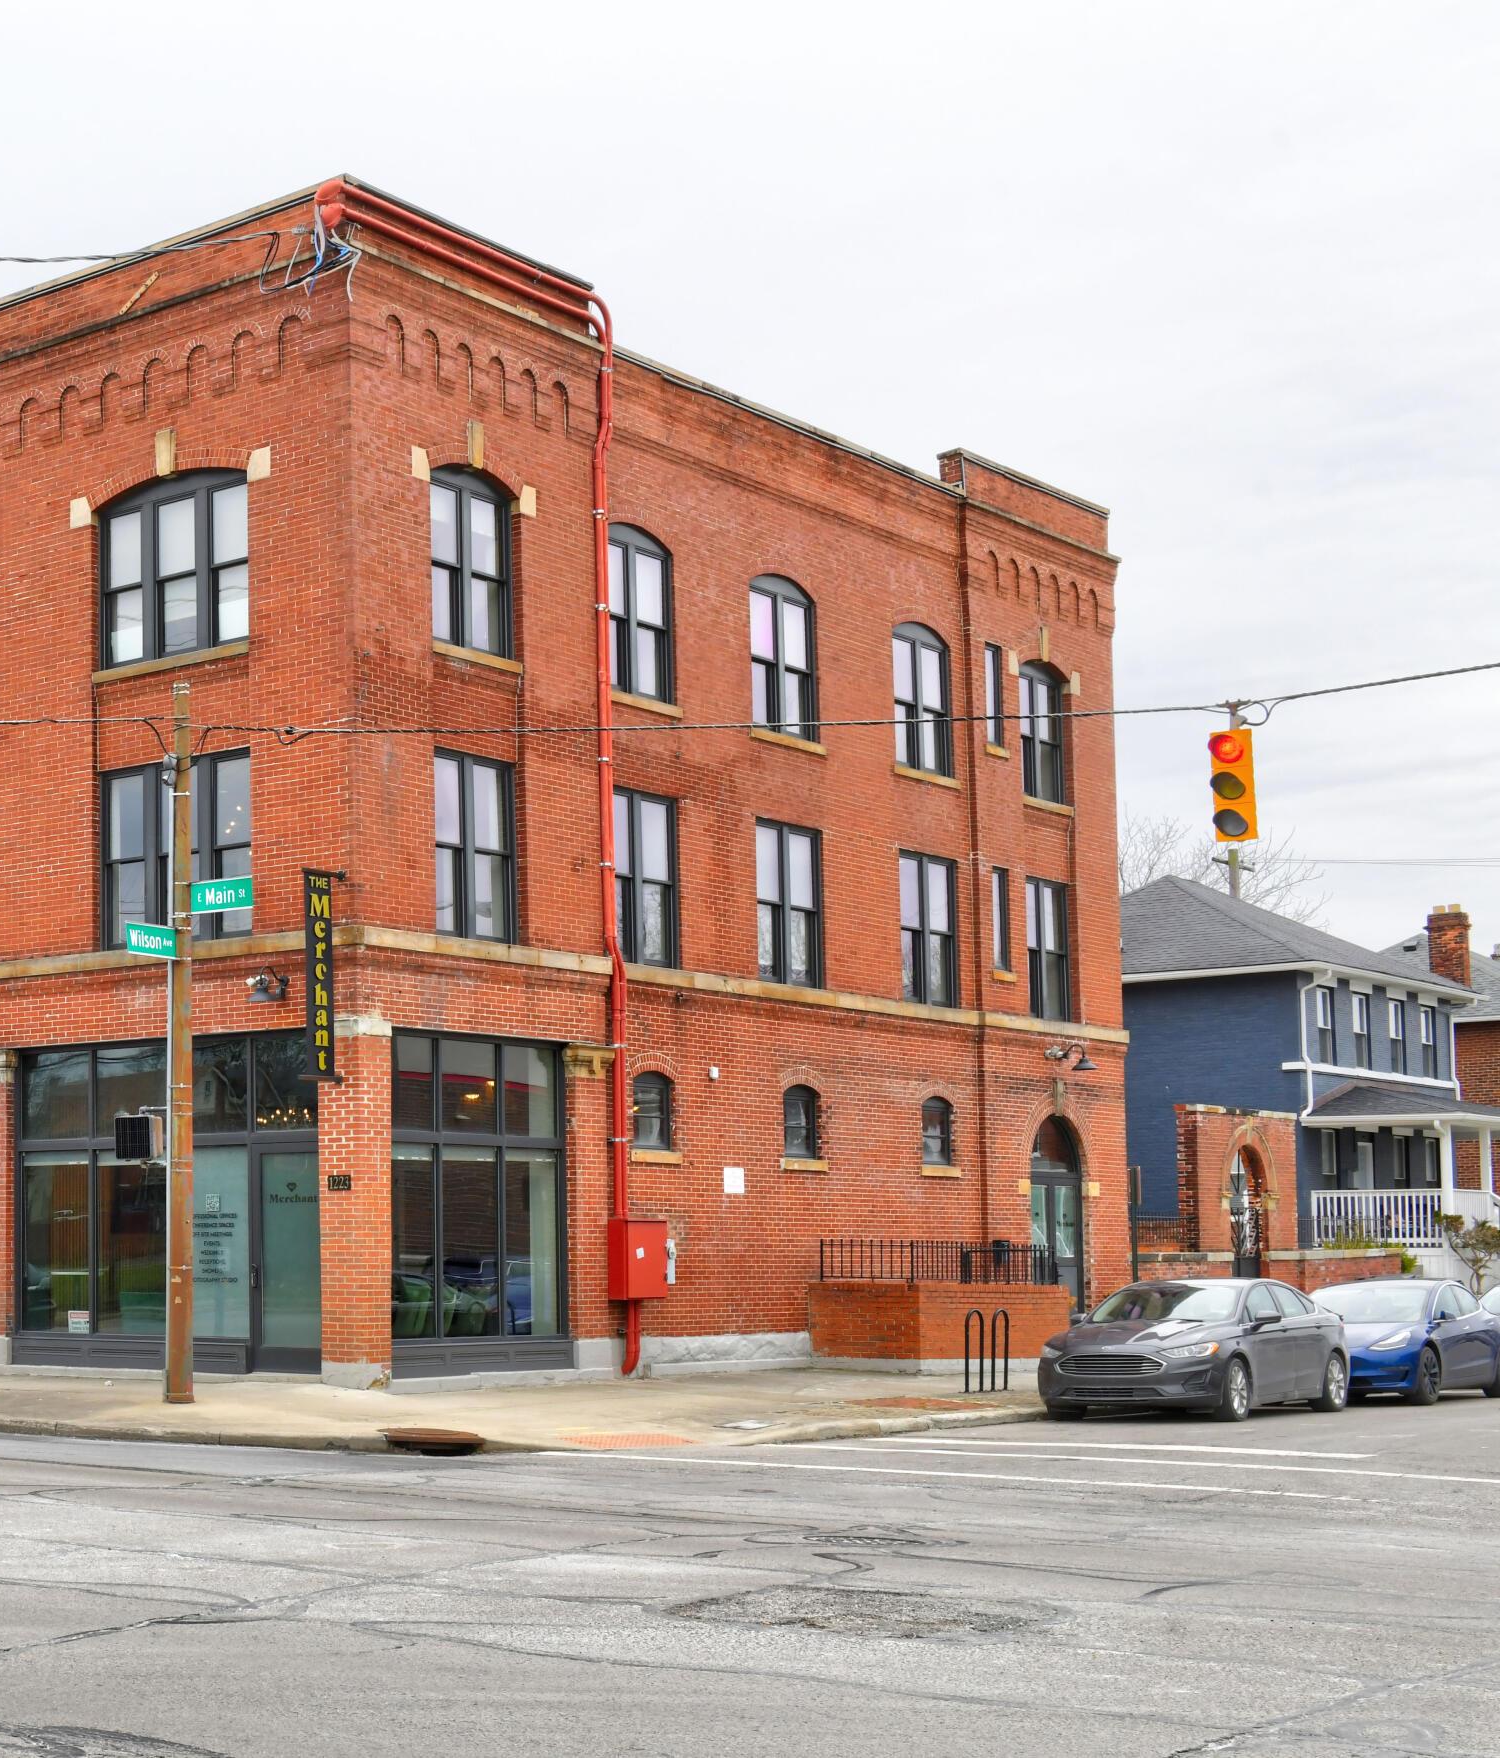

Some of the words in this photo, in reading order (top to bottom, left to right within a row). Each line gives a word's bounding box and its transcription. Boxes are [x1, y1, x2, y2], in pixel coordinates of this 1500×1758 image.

[308, 875, 329, 889] THE
[197, 892, 202, 903] E
[205, 886, 235, 905] Main
[238, 888, 246, 898] St
[129, 929, 162, 950] Wilson
[163, 937, 173, 947] Ave
[309, 892, 331, 1071] Merchant
[329, 1176, 349, 1190] 1223
[269, 1193, 318, 1204] Merchant
